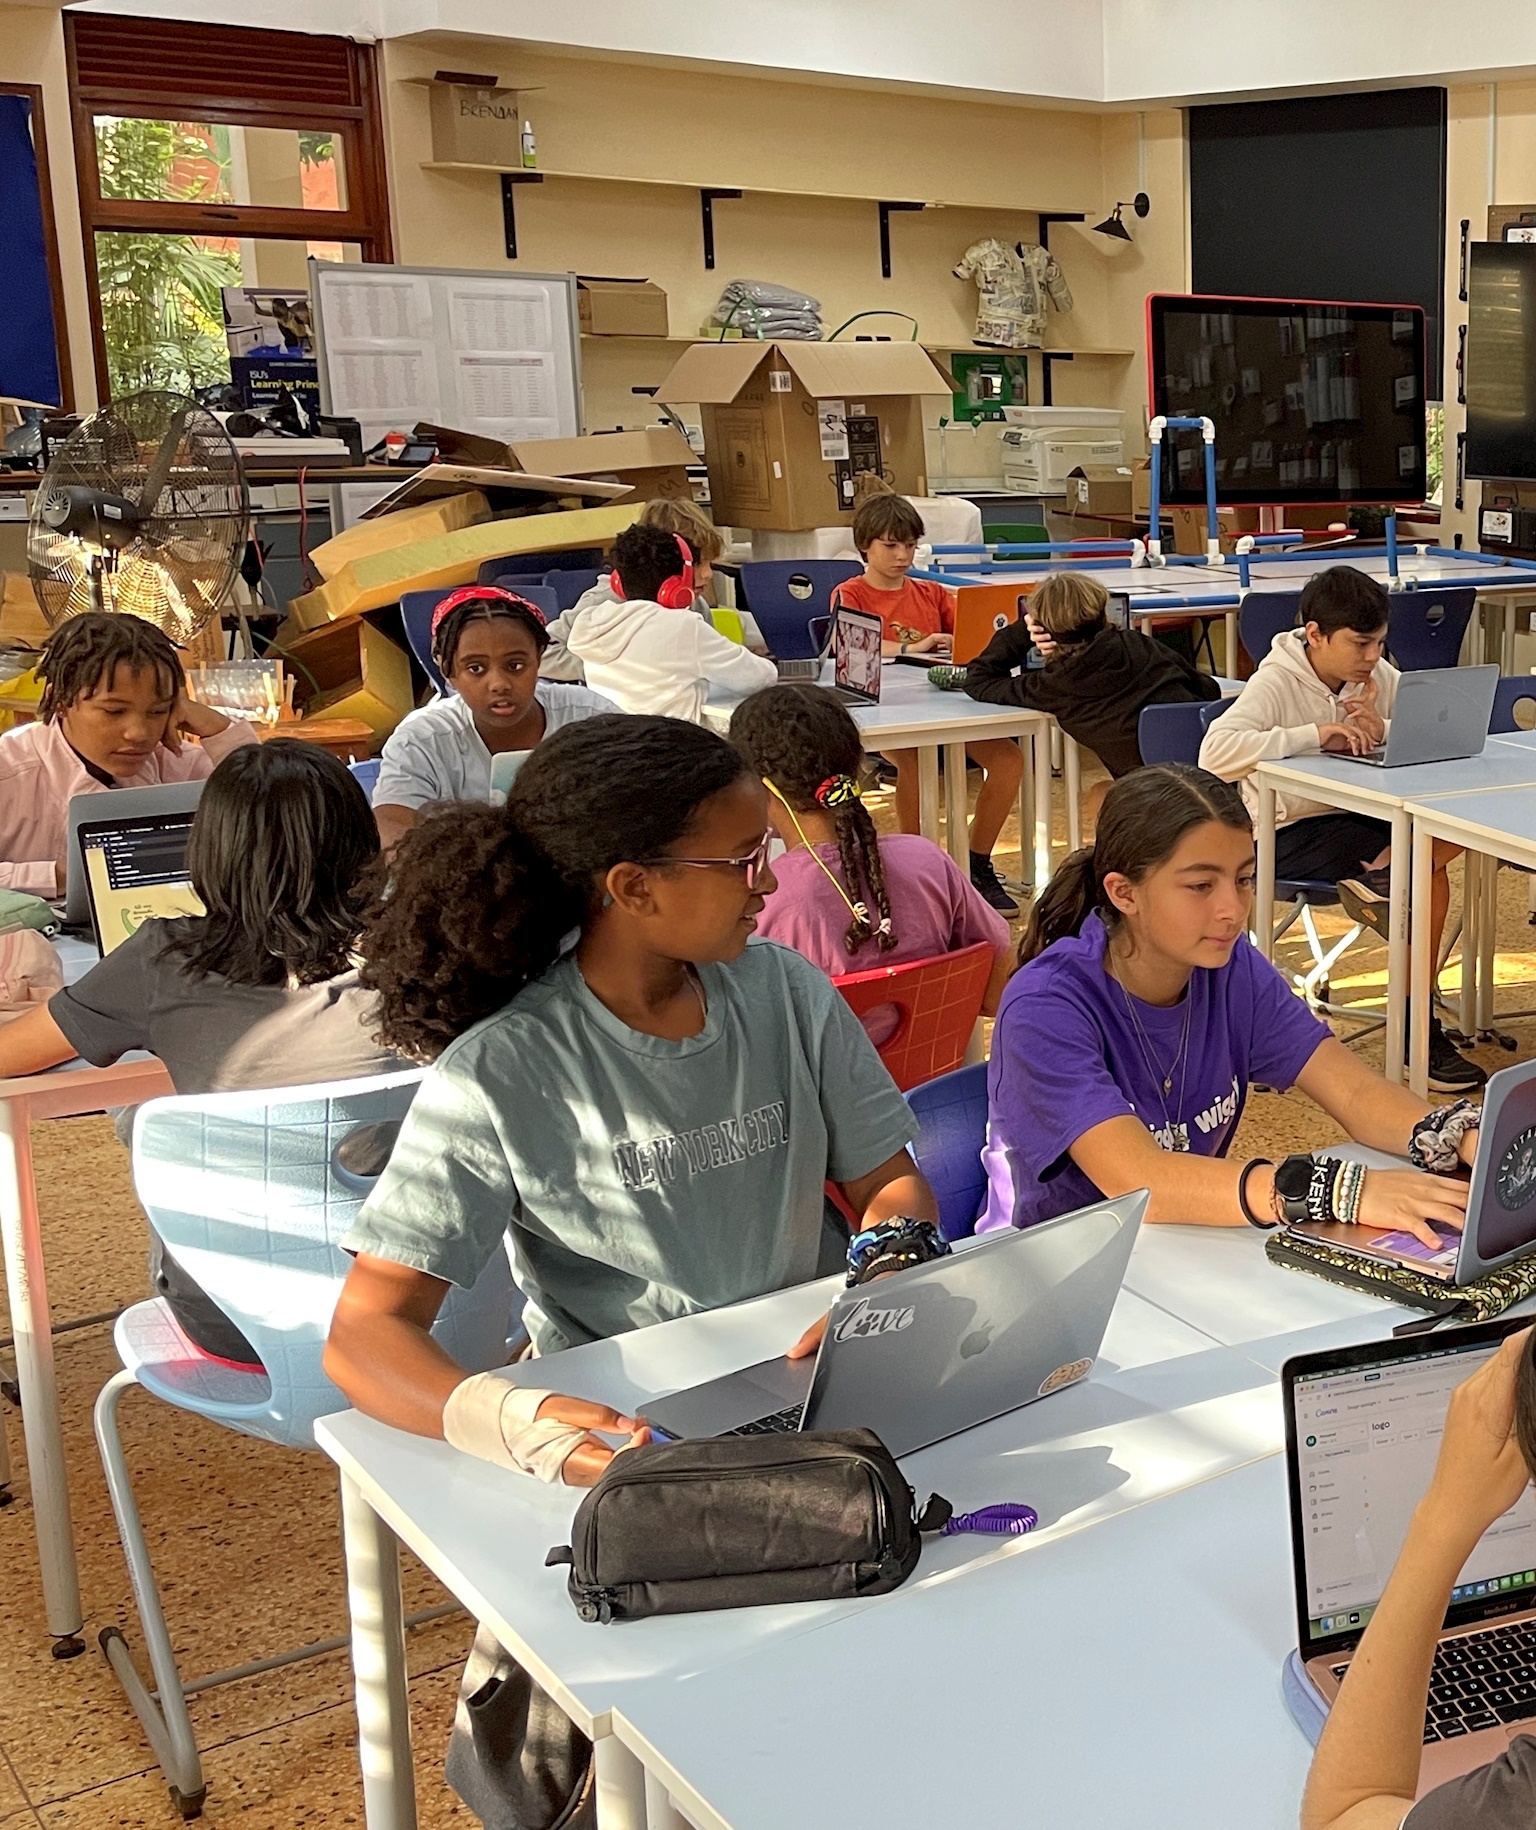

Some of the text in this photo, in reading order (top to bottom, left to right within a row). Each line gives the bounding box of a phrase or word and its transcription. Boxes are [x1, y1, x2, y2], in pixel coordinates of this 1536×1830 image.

[614, 1100, 788, 1192] NEW YORK CITY
[1371, 1420, 1391, 1431] logo
